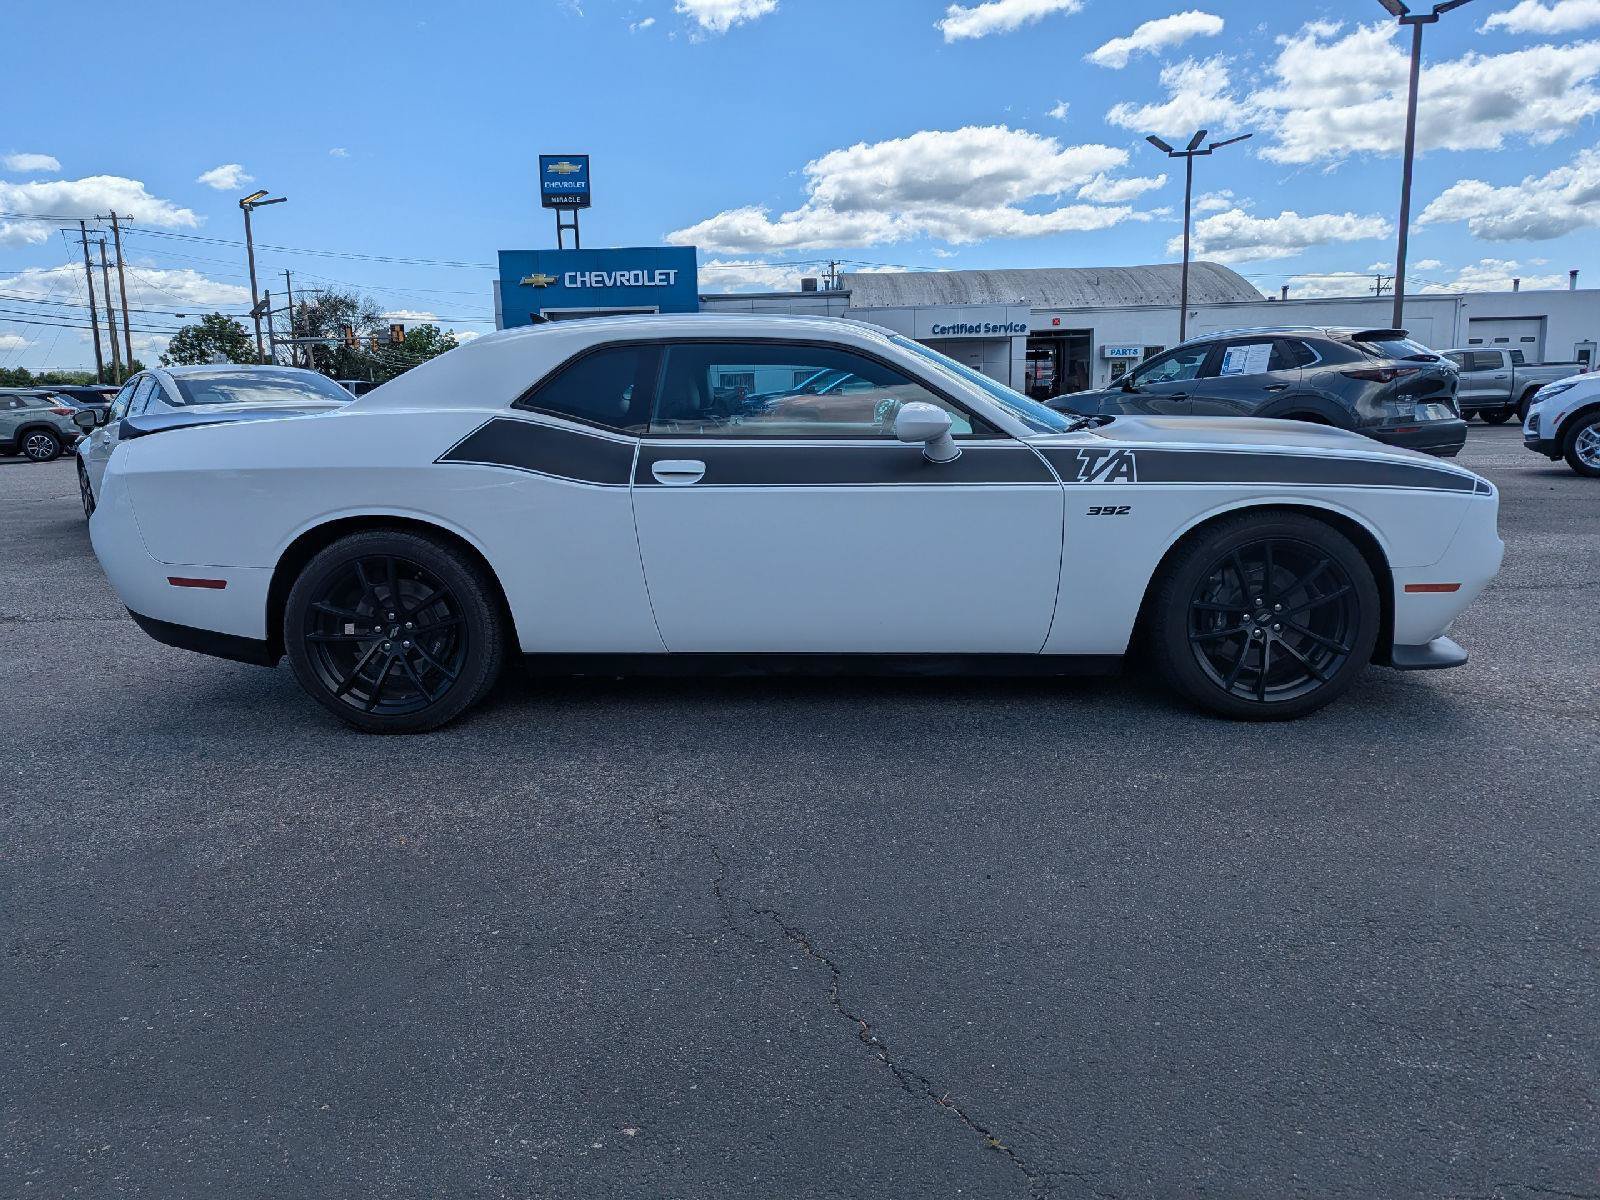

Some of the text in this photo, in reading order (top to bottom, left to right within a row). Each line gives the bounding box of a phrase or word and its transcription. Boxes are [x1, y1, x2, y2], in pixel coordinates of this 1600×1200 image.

[564, 269, 678, 288] CHEVROLET
[931, 321, 1027, 335] Certified Service
[1110, 348, 1139, 356] PARTS
[1086, 505, 1131, 516] 392
